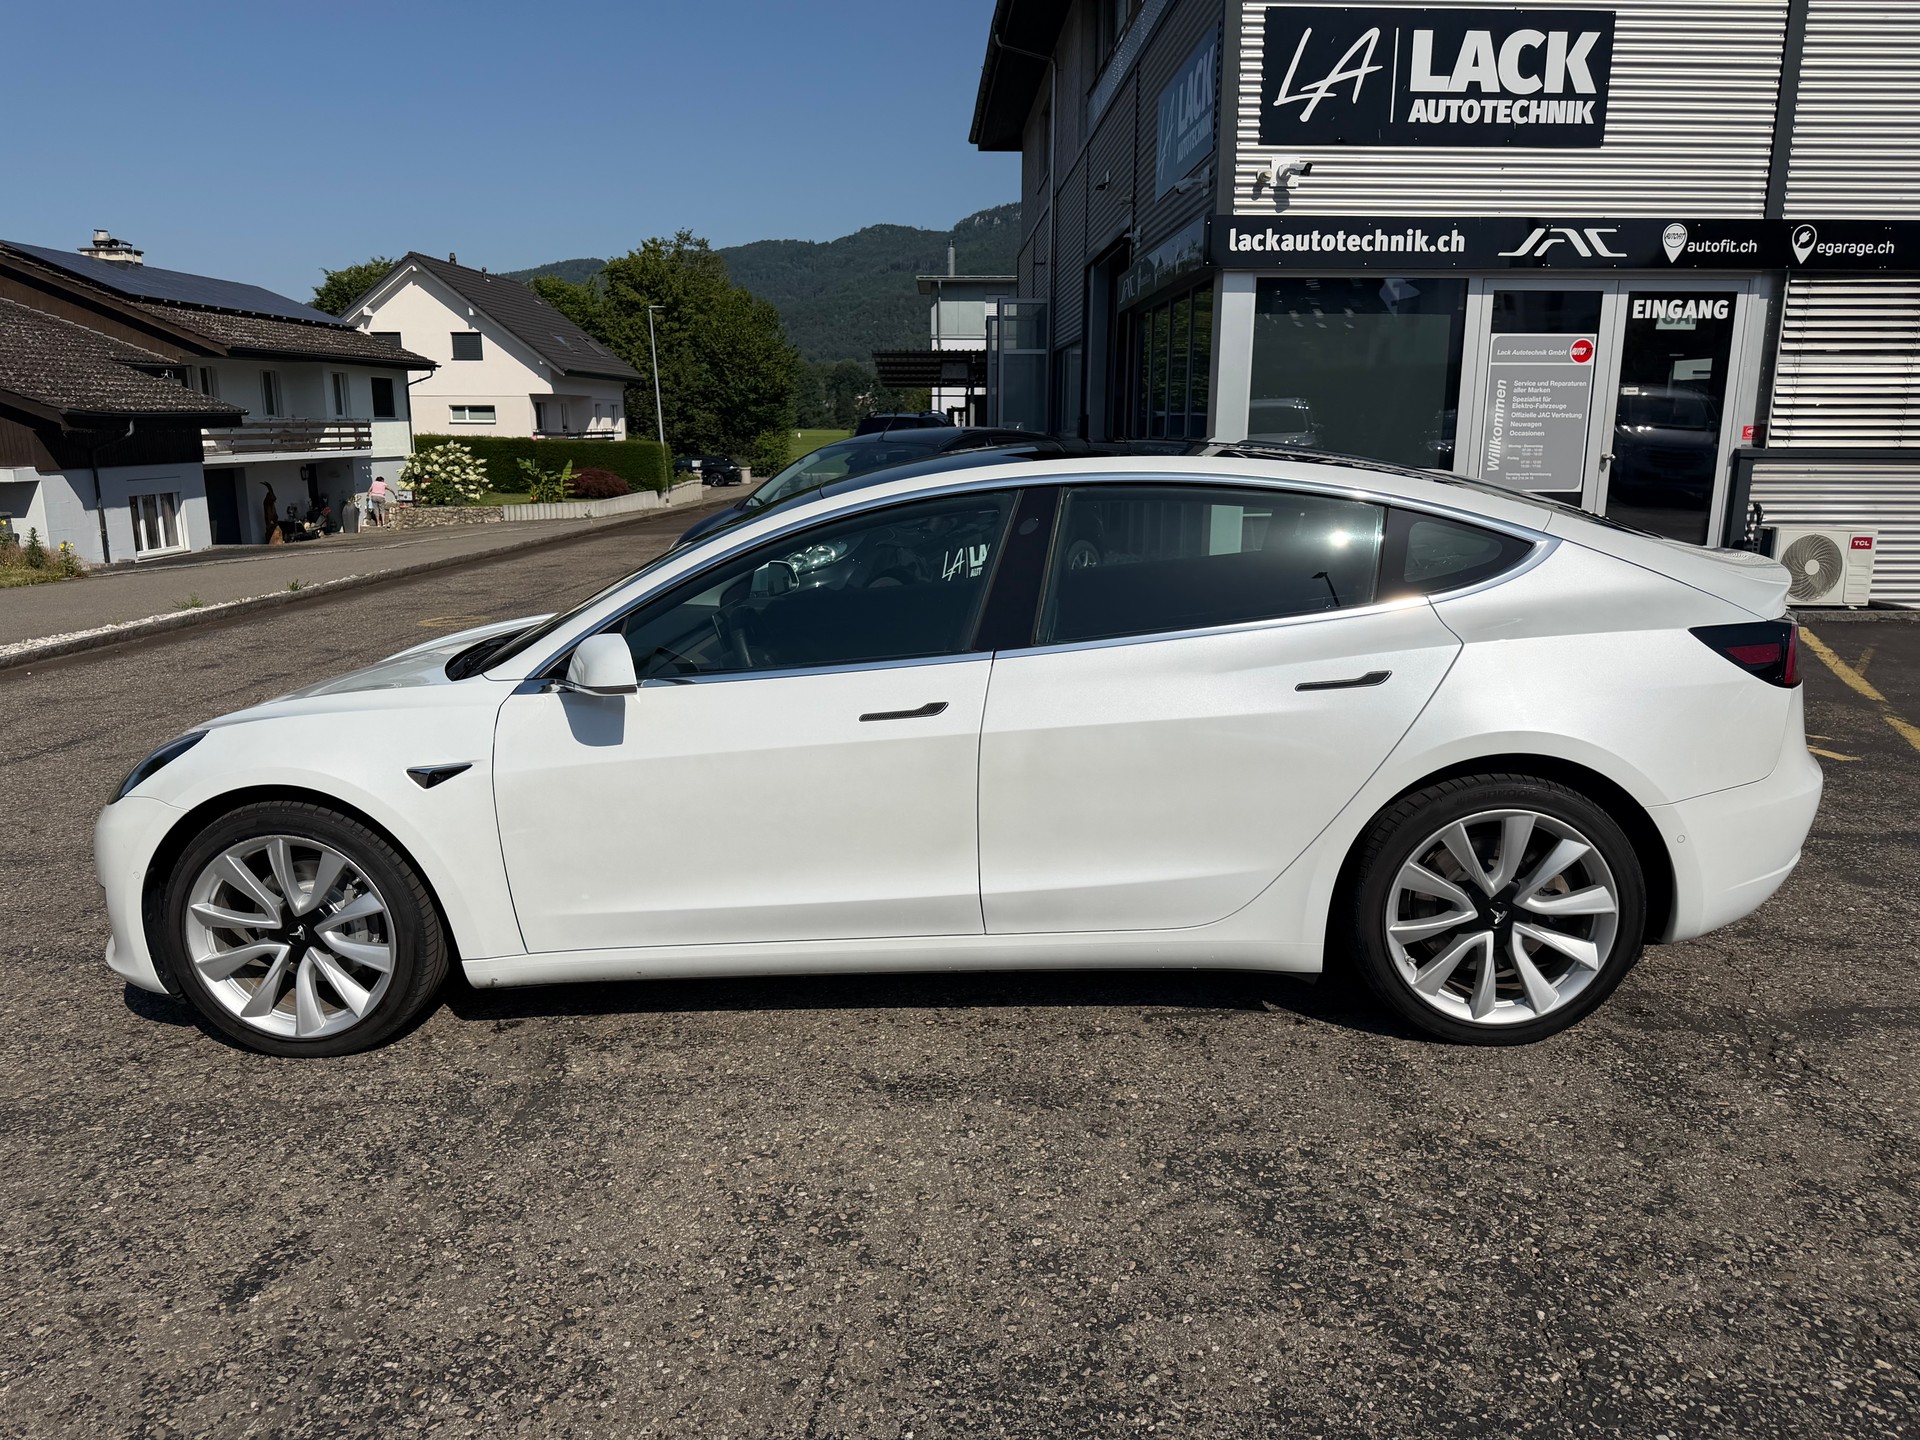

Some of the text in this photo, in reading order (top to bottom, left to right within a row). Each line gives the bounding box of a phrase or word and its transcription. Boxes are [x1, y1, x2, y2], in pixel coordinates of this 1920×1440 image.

[1410, 29, 1601, 95] LACK
[1177, 43, 1215, 138] LACK
[1408, 99, 1596, 124] AUTOTECHNIK
[1177, 110, 1213, 164] AUTOTECHNIK
[1229, 228, 1466, 253] lackautotechnik.ch
[1687, 239, 1757, 253] autofit.ch
[1817, 241, 1895, 256] egarage.ch
[1632, 299, 1729, 319] EINGANG
[1550, 380, 1587, 388] Reparaturen
[1487, 379, 1507, 471] Willkommen
